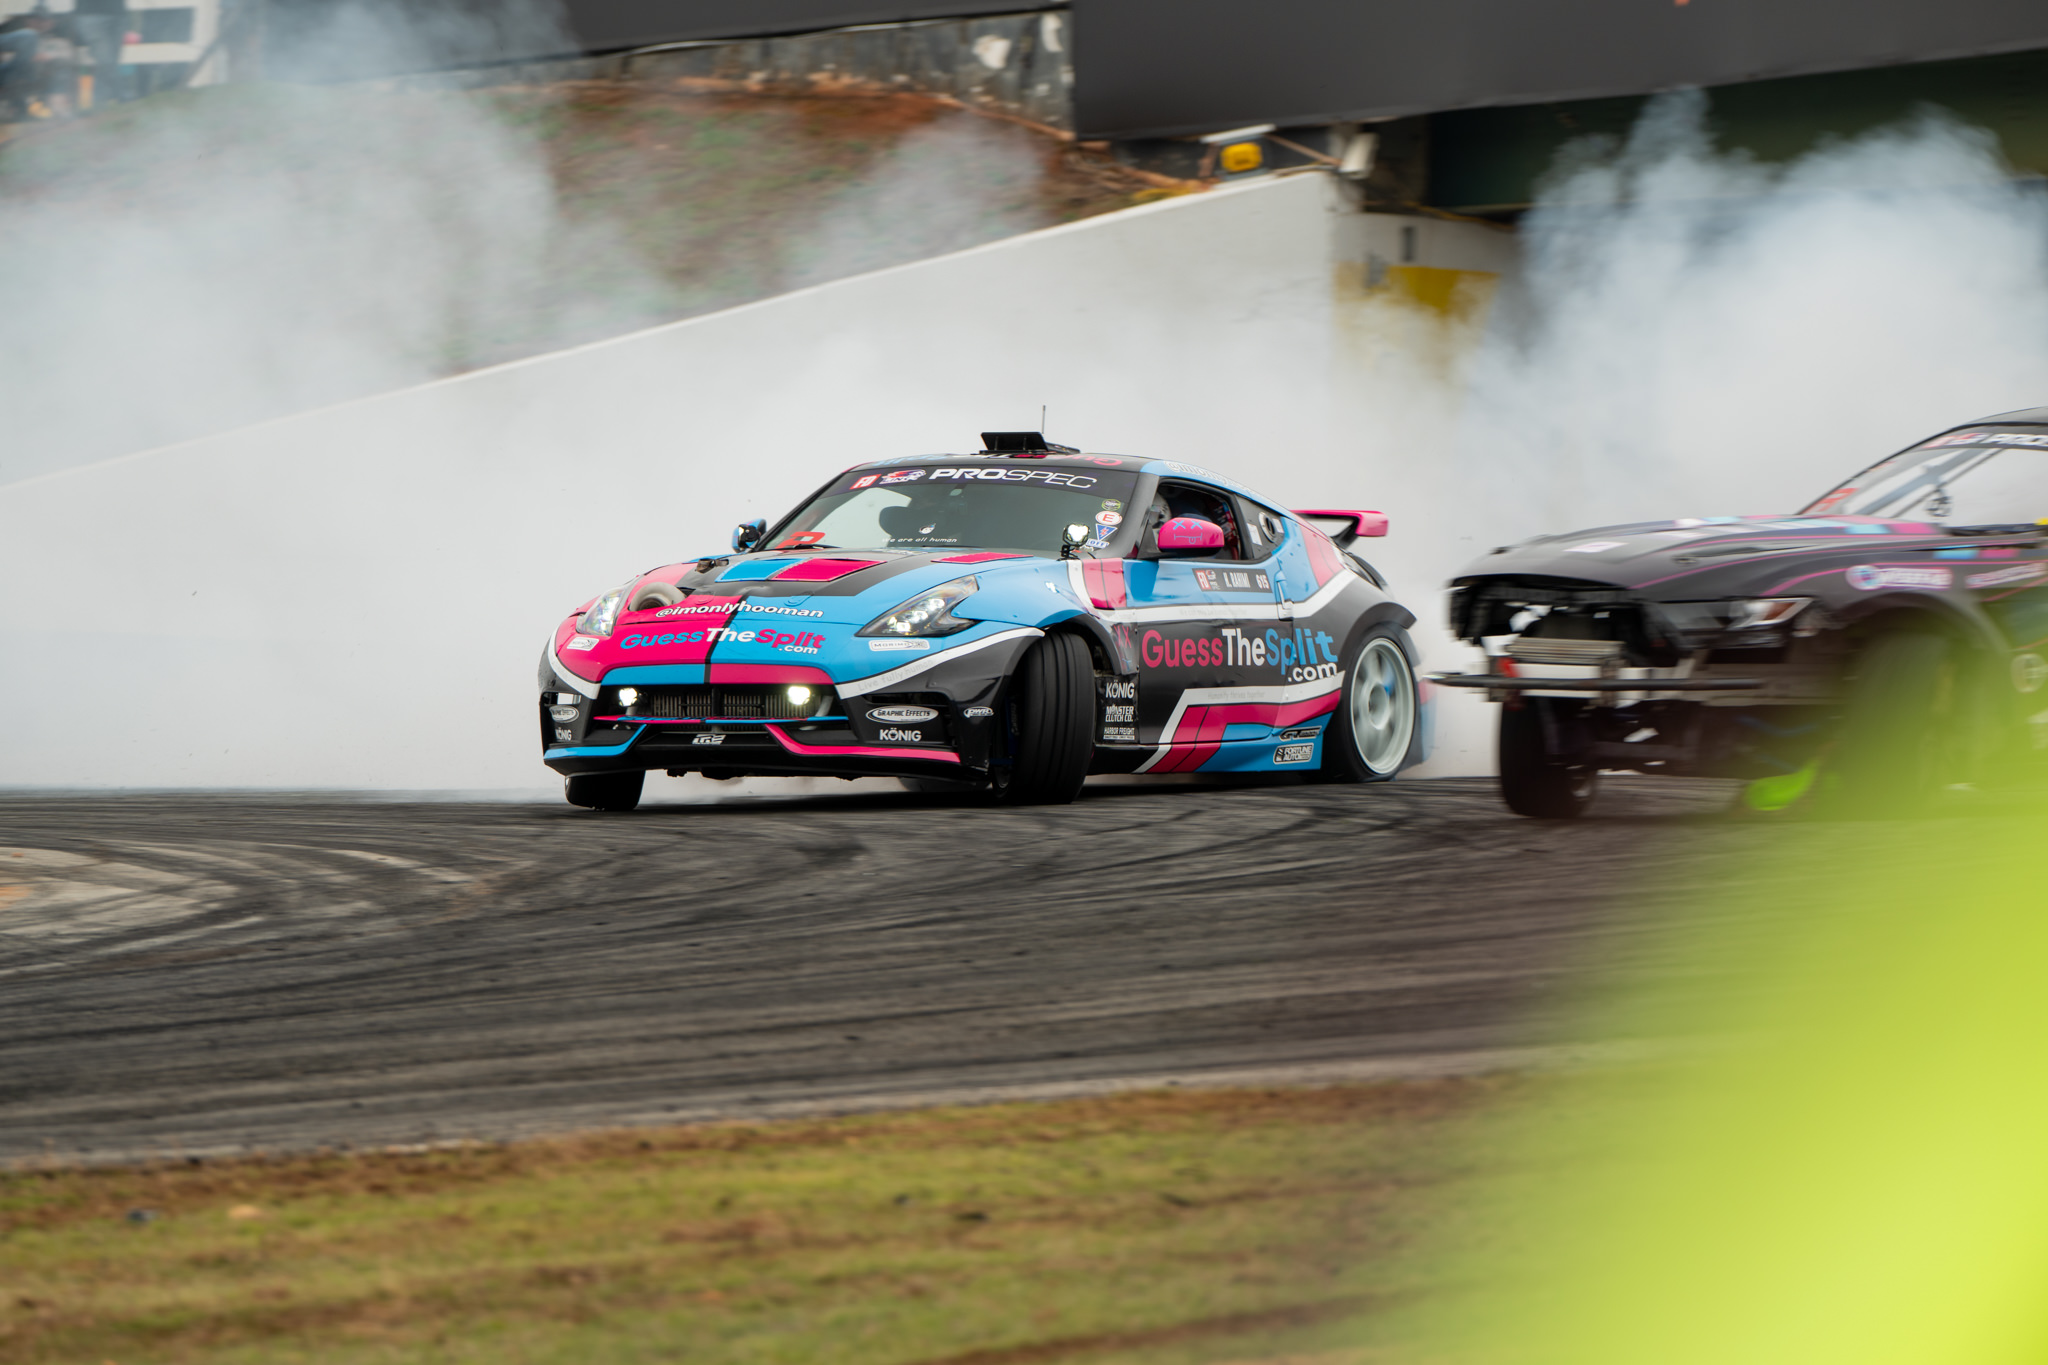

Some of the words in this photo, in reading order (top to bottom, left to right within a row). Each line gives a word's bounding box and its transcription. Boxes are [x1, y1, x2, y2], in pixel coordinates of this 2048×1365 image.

[929, 468, 1098, 489] PROSPEC
[1102, 513, 1115, 523] E
[1256, 574, 1270, 590] 615
[655, 601, 825, 618] @imonlyhooman
[620, 627, 826, 650] GuessTheSplit
[778, 644, 819, 655] .com
[1141, 627, 1339, 676] GuessTheSplit
[857, 679, 880, 692] Live
[881, 670, 904, 685] fully
[904, 659, 935, 674] human
[1287, 662, 1338, 683] .com
[1105, 679, 1135, 699] KÖNIG
[876, 708, 904, 717] GRAPHIC
[904, 709, 931, 717] EFFECTS
[879, 727, 922, 741] KÖNIG
